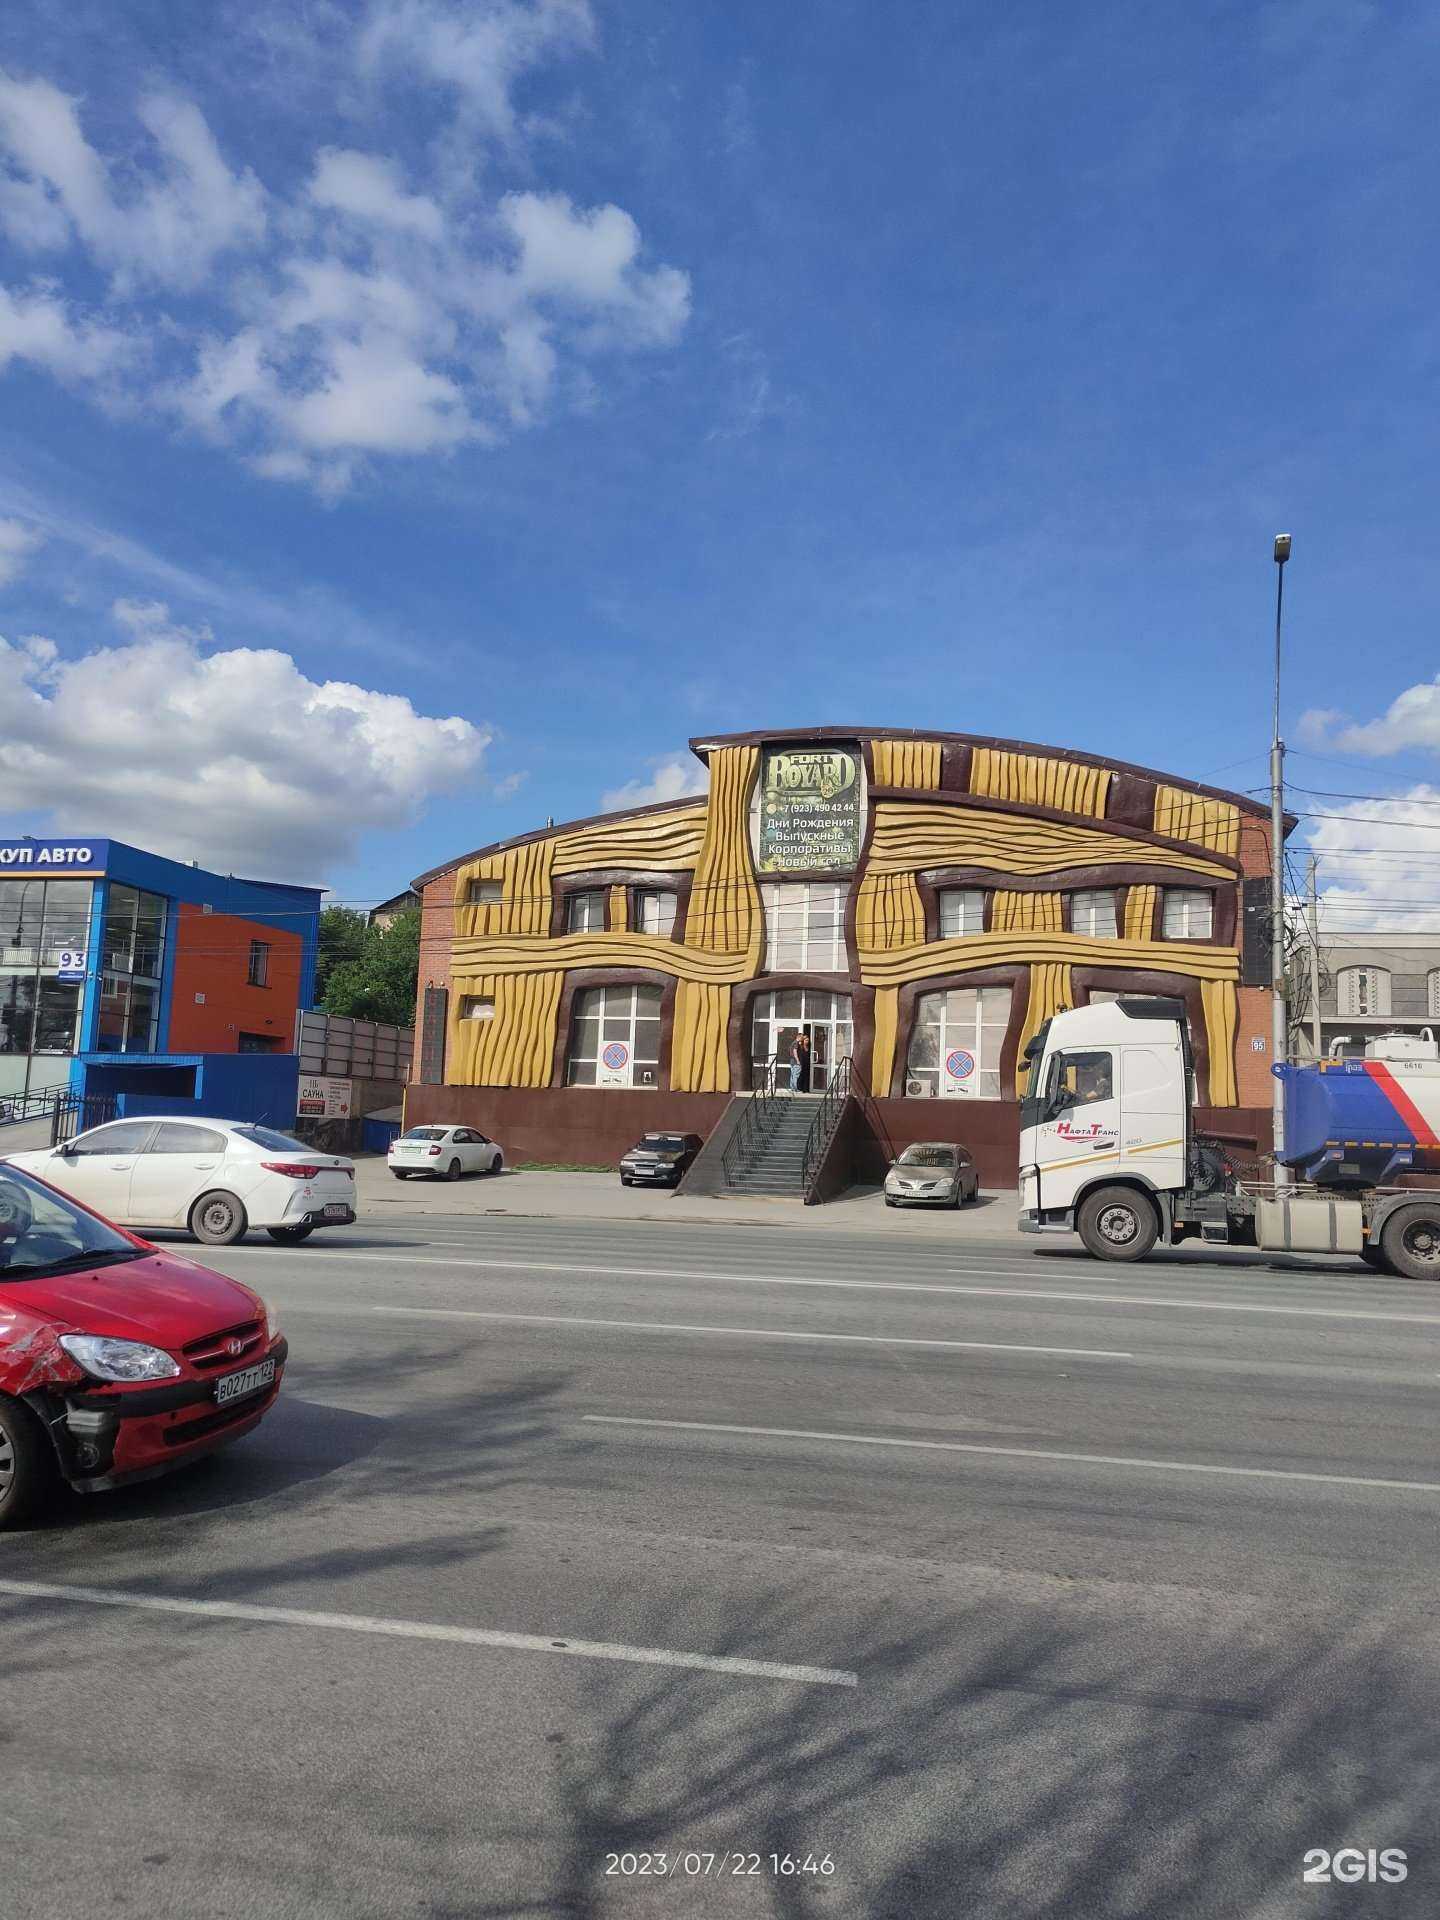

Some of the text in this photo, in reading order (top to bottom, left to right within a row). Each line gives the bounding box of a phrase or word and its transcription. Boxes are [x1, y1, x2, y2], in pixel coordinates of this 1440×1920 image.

[791, 755, 831, 764] FORT
[791, 804, 813, 813] (923)
[815, 804, 830, 812] 490
[832, 804, 842, 812] 42
[844, 803, 854, 811] 44
[767, 818, 854, 830] Дни Рождения
[776, 831, 845, 843] Выпускные
[37, 847, 91, 863] АВТО
[768, 844, 852, 855] Корпоративы
[778, 856, 840, 867] Новый год
[62, 953, 84, 967] 93
[1253, 1042, 1264, 1050] 95
[303, 1089, 324, 1098] САУНА
[261, 1361, 273, 1377] 122
